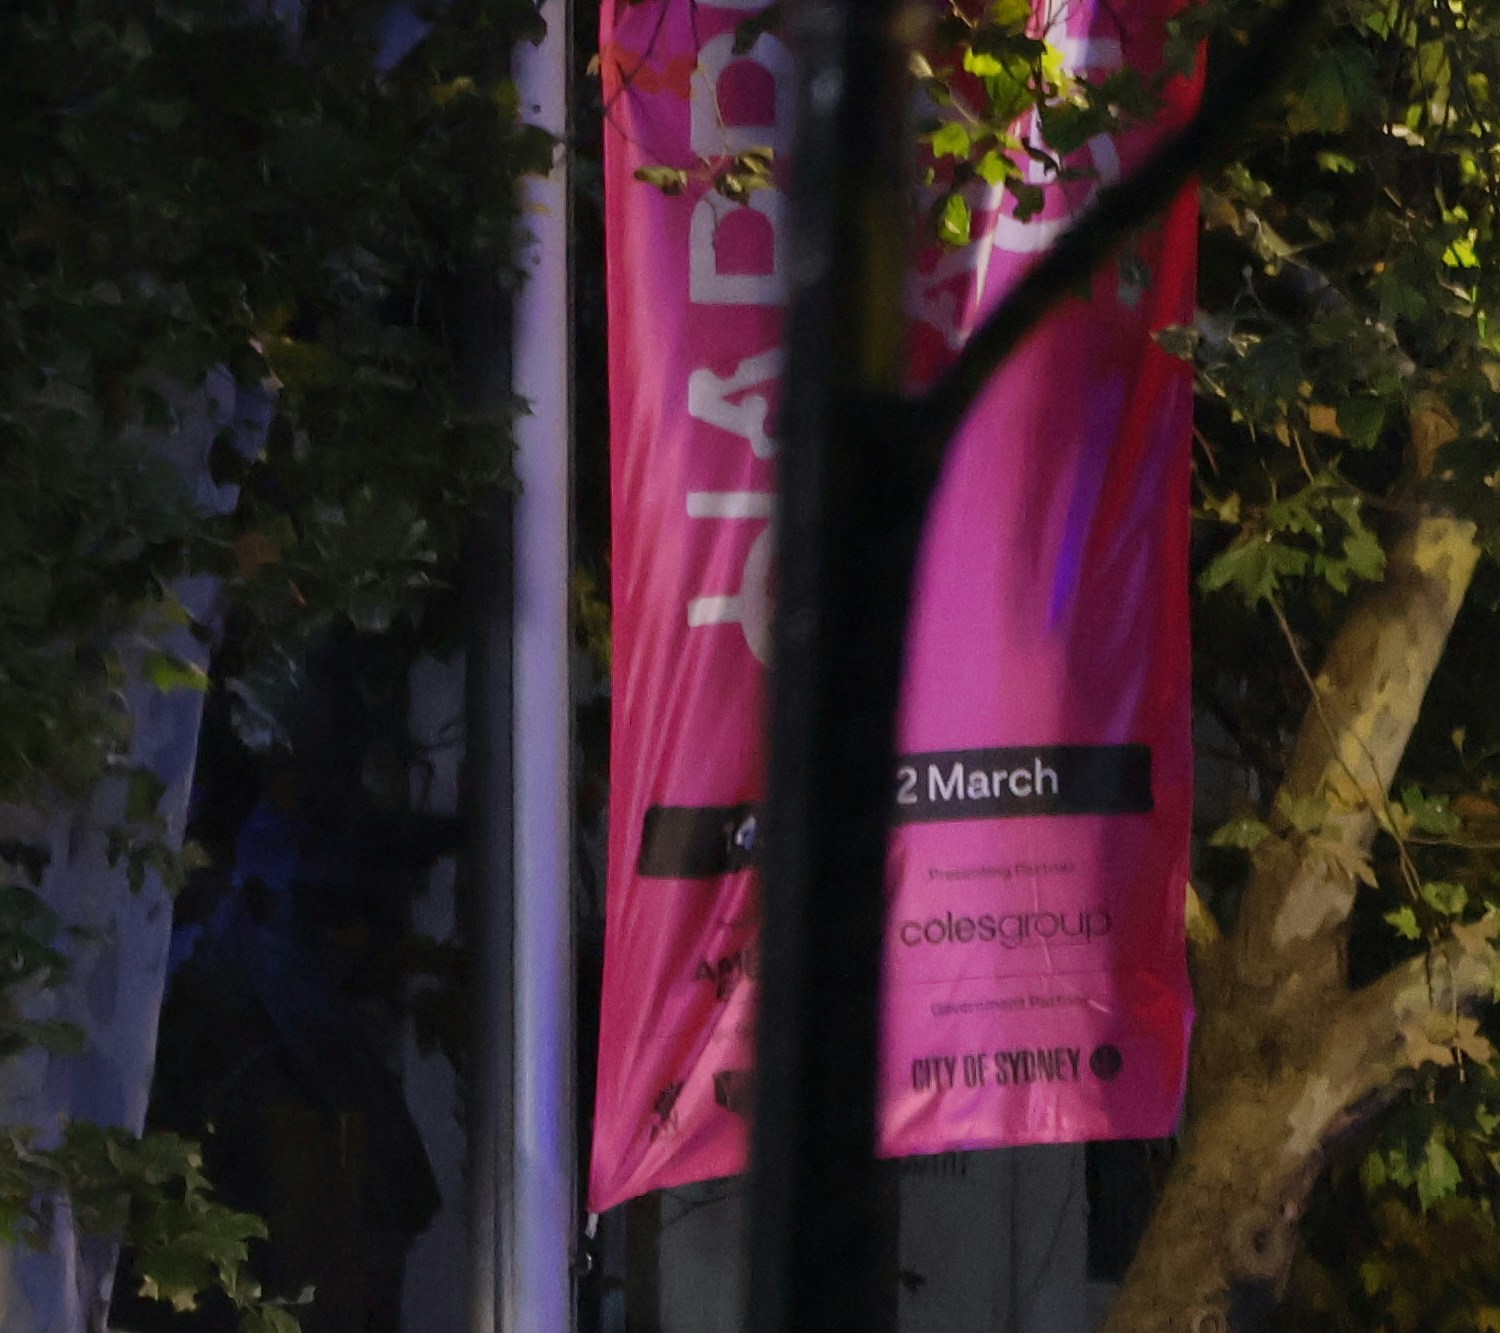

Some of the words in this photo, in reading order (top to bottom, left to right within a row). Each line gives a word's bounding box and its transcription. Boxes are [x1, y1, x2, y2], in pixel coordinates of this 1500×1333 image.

[896, 764, 919, 805] 2
[927, 756, 1060, 803] March
[912, 1054, 957, 1091] CITY
[964, 1052, 987, 1088] OF
[995, 1047, 1081, 1086] SYDNEY
